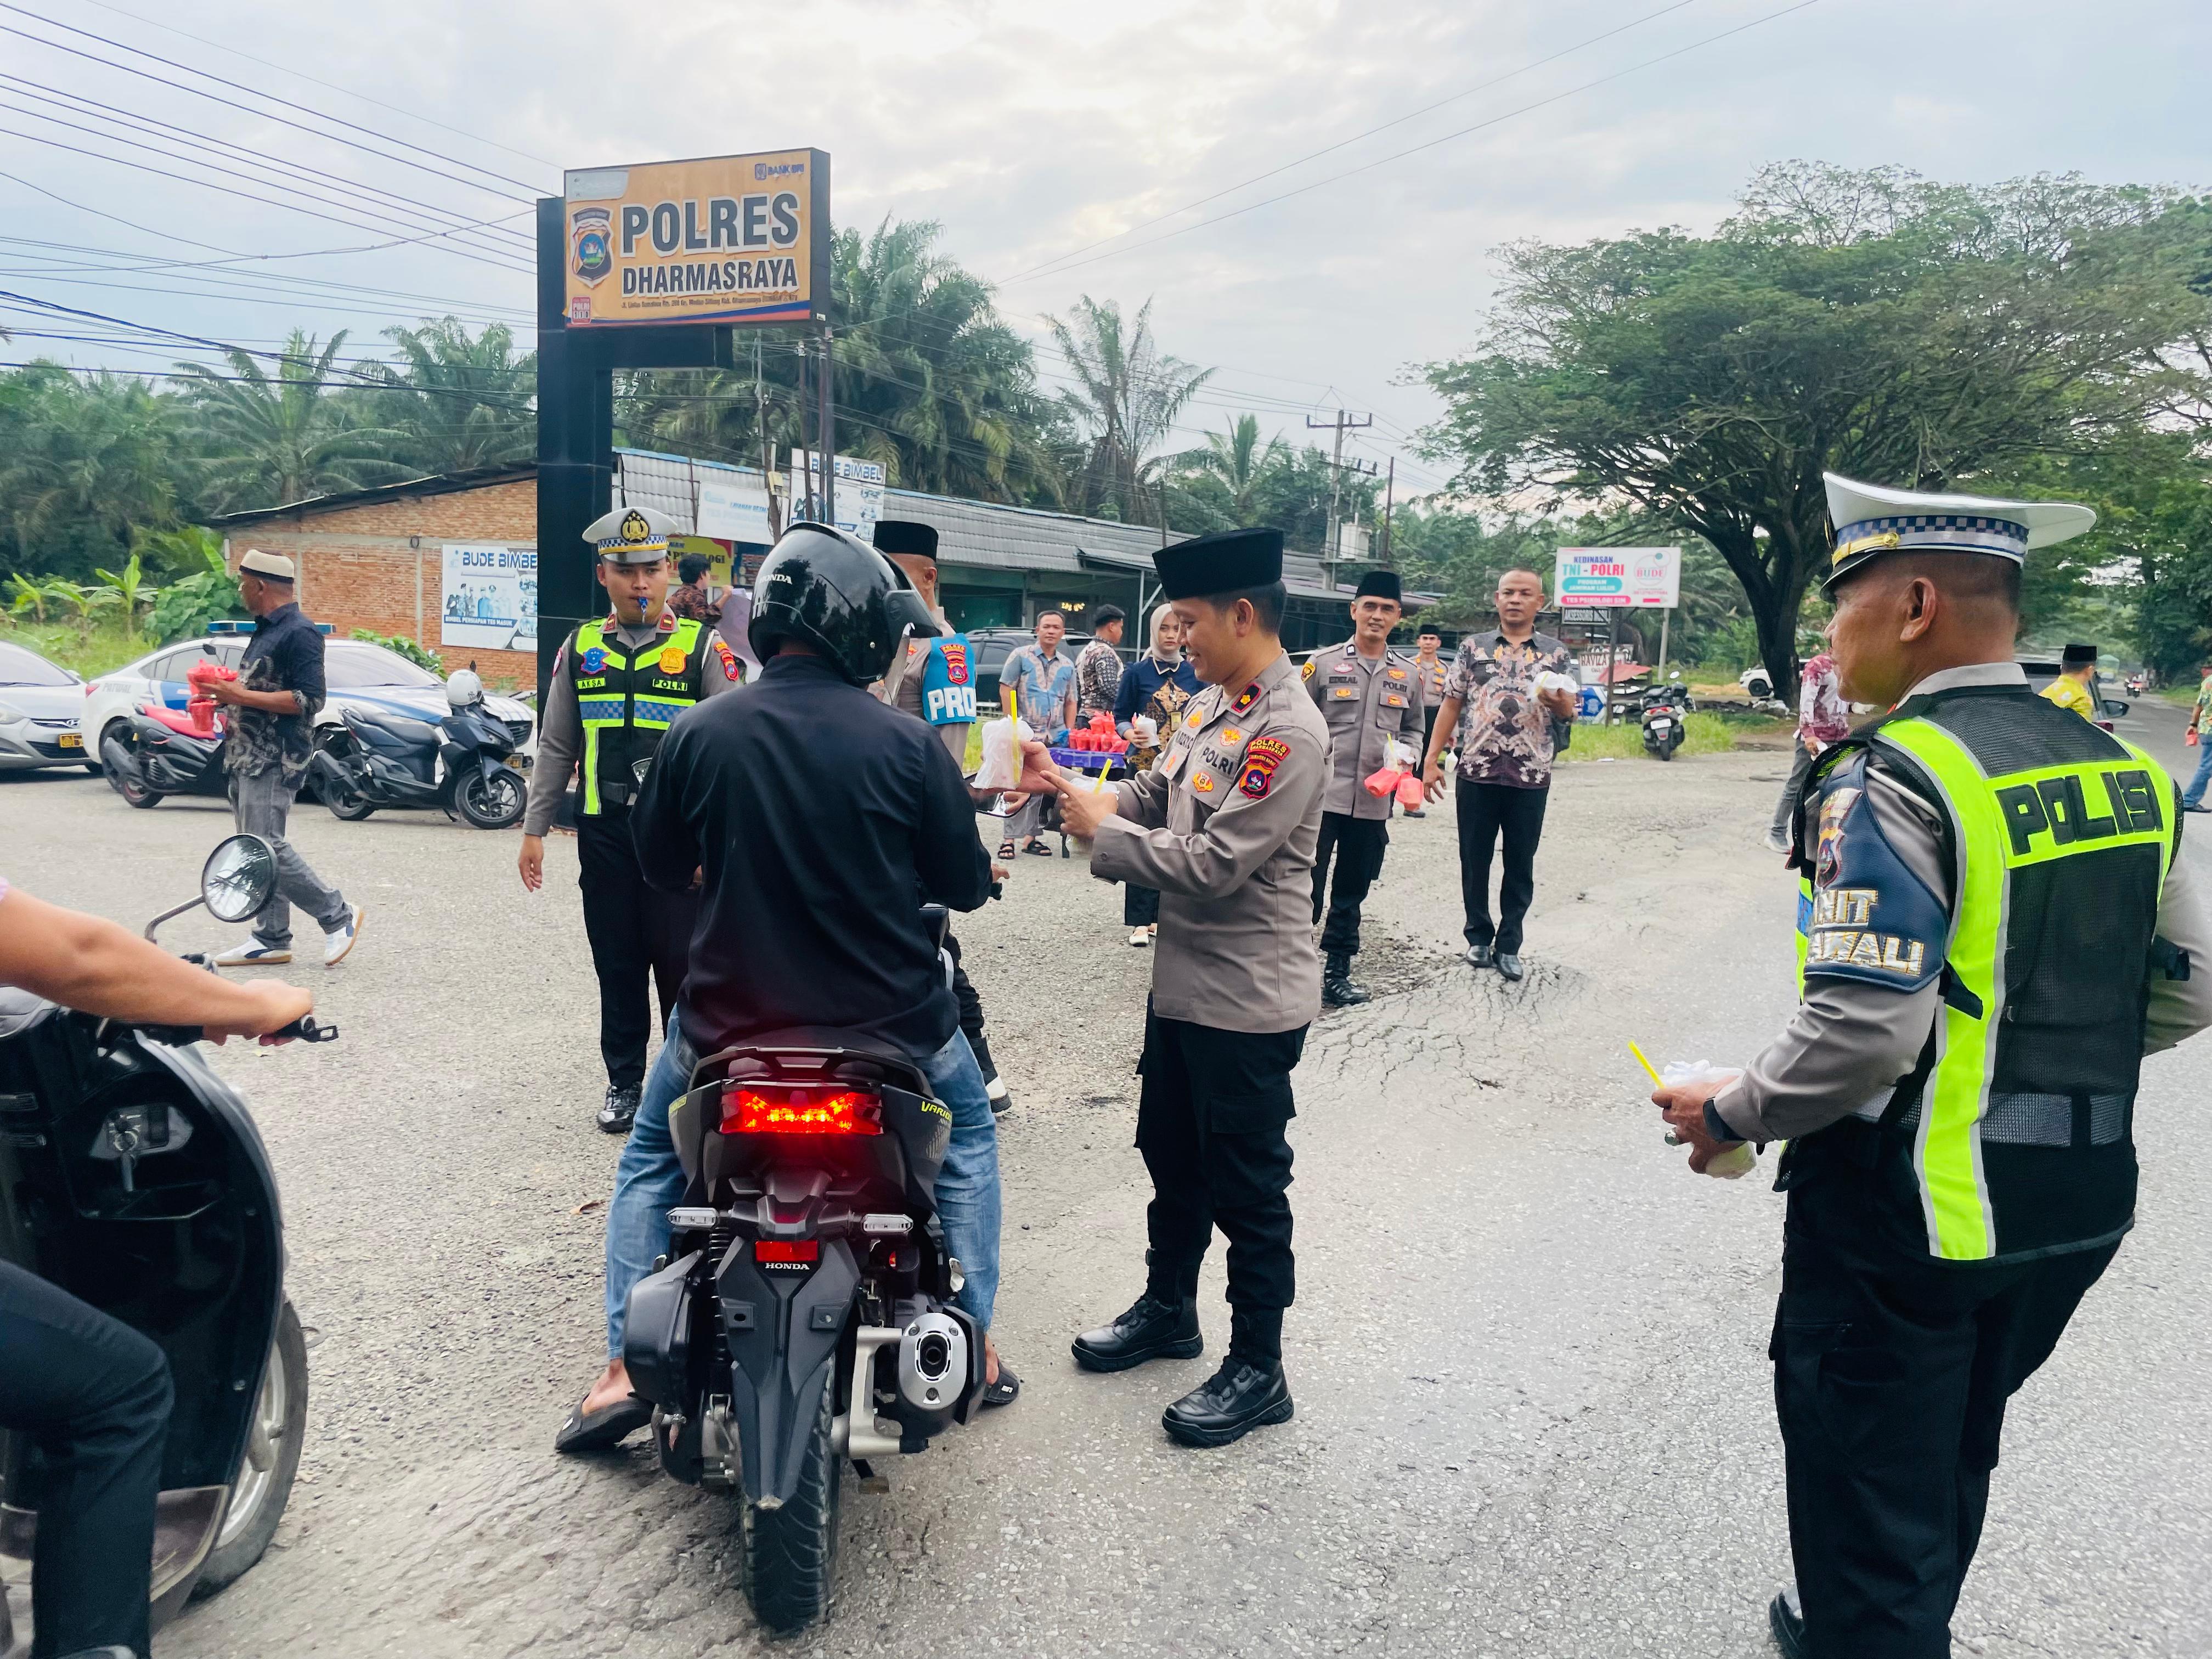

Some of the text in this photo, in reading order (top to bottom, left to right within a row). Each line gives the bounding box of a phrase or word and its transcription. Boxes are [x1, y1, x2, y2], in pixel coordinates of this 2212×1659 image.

[622, 193, 799, 254] POLRES
[623, 259, 798, 295] DHARMASRAYA
[812, 458, 882, 481] BE BIMBEL
[463, 551, 494, 567] BUDE
[759, 573, 793, 585] HONDA
[1562, 565, 1581, 575] TNI
[1591, 564, 1624, 575] POLRI
[581, 679, 602, 689] AKSA
[1383, 680, 1408, 692] POLRI
[1251, 739, 1287, 753] POLRES
[1200, 746, 1233, 775] POLRI
[1994, 770, 2164, 856] POLISI
[1814, 890, 1878, 923] NIT
[921, 1101, 951, 1120] VARIO
